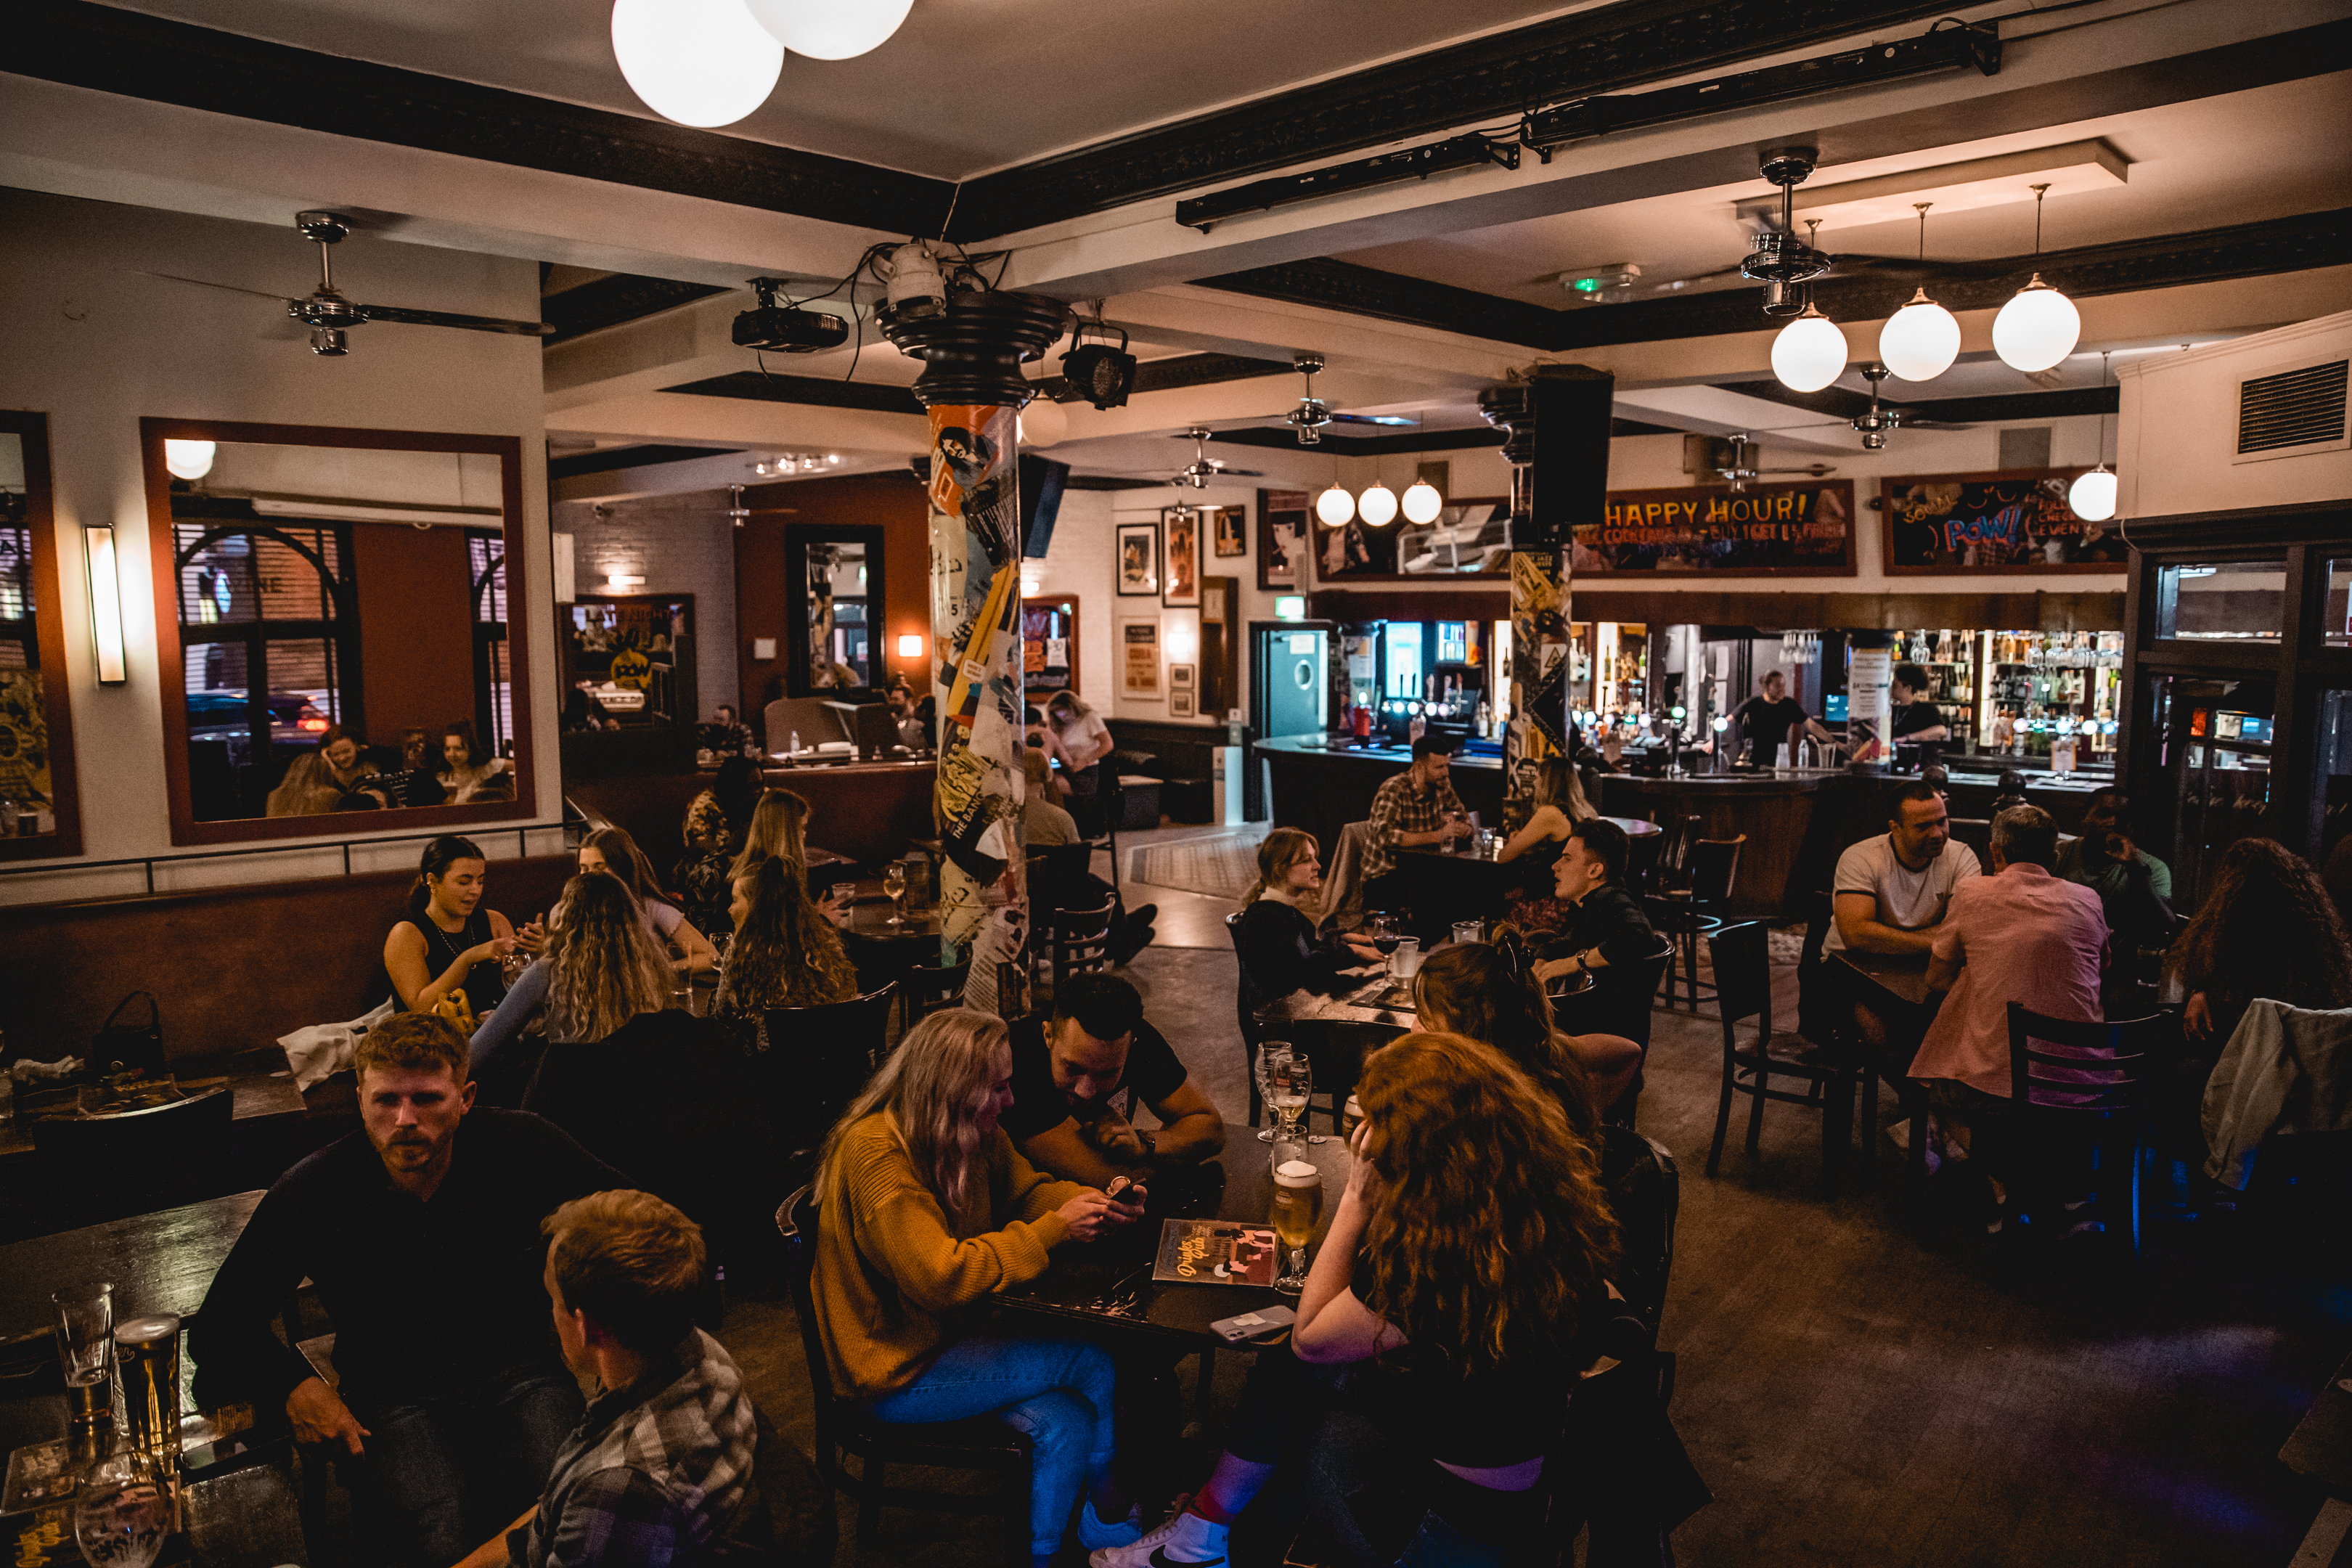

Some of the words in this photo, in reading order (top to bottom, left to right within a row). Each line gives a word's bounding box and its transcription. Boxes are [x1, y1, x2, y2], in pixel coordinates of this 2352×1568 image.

[1604, 502, 1698, 527] HAPPY
[1708, 493, 1807, 523] HOUR!
[1944, 504, 2022, 552] POW!
[952, 820, 968, 839] THE
[1177, 1240, 1197, 1277] Drinks
